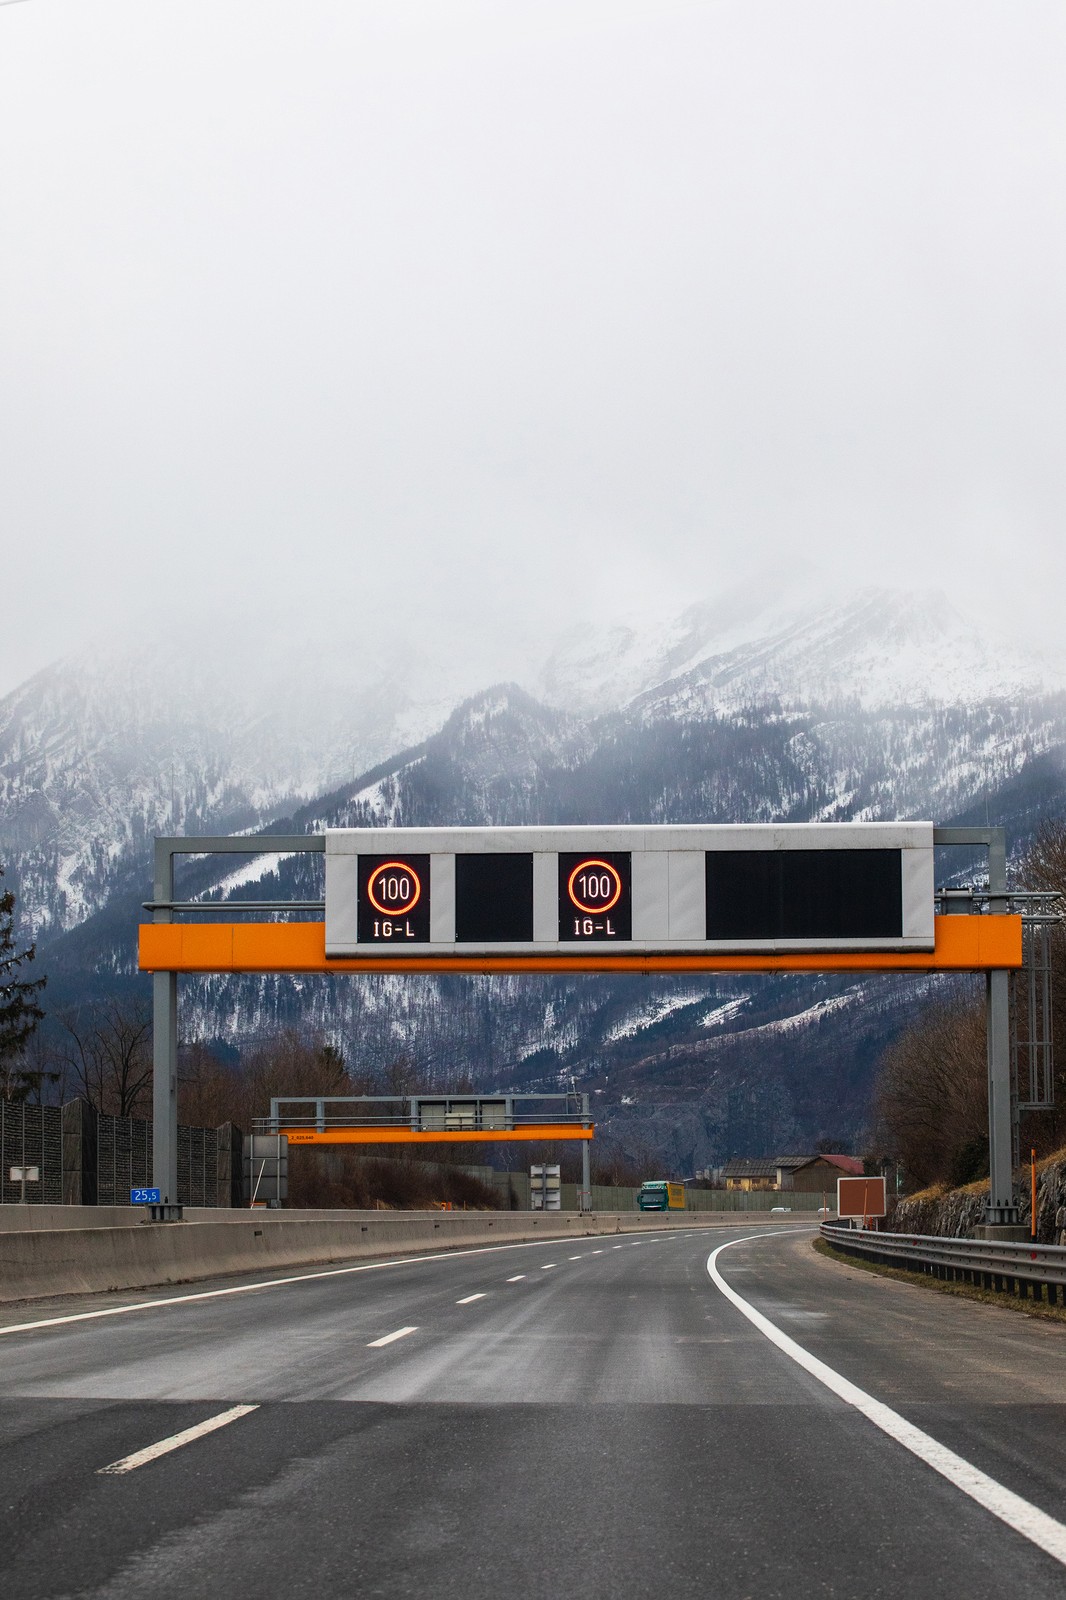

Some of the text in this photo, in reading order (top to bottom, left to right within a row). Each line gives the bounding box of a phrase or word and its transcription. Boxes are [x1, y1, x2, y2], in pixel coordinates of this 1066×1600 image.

[378, 877, 410, 900] 100
[579, 875, 610, 898] 100
[374, 921, 415, 937] IG-L
[574, 919, 616, 935] IG-L
[134, 1190, 157, 1202] 25,5
